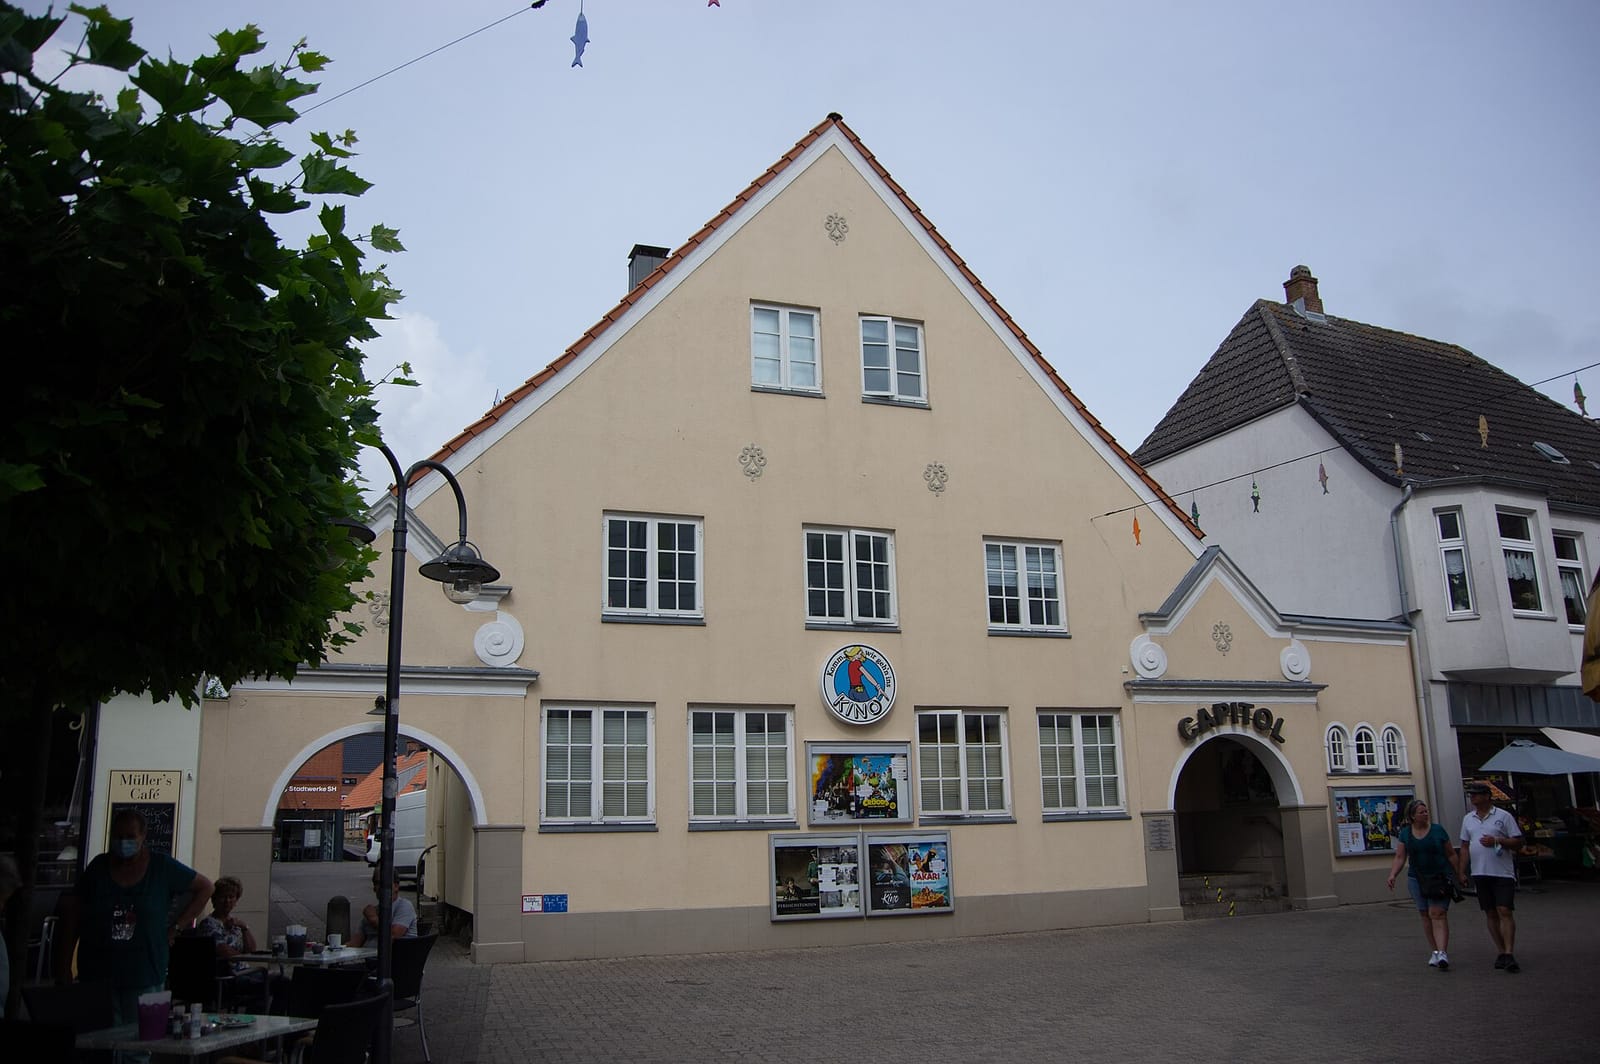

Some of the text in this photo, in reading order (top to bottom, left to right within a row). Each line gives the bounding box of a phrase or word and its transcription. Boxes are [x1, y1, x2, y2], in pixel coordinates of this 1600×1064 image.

[865, 650, 877, 659] wir
[833, 695, 882, 719] KINO
[1178, 702, 1286, 744] CAPITOL
[120, 774, 172, 786] Müller's
[130, 788, 160, 800] Café
[911, 872, 940, 881] YAKARI
